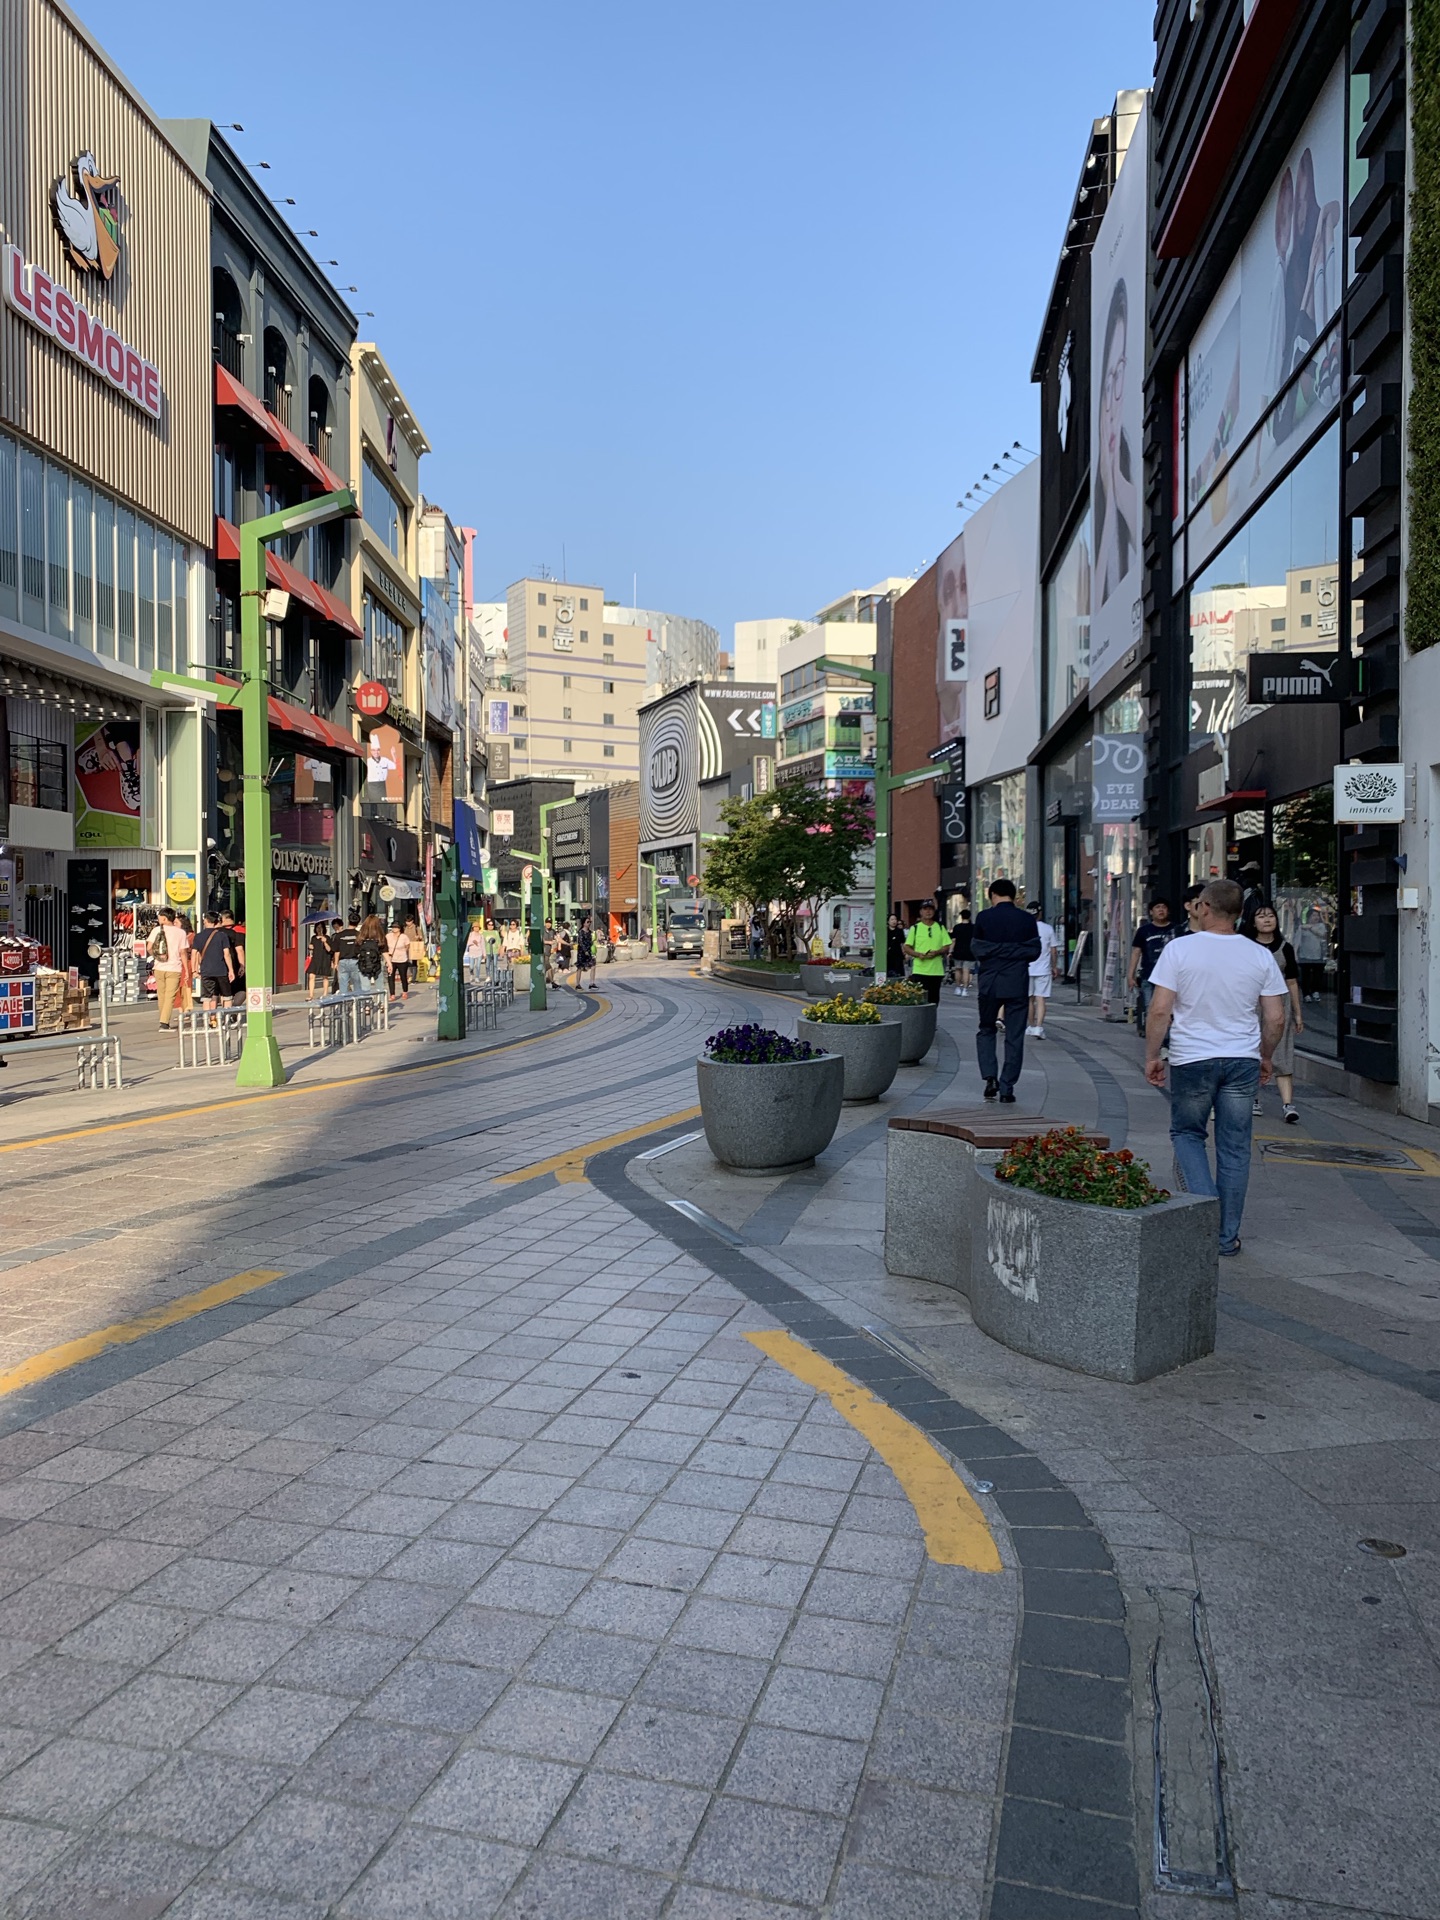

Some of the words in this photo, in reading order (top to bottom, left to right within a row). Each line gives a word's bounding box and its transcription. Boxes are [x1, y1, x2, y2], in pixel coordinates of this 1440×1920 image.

[12, 250, 160, 413] LESMORE
[950, 628, 965, 671] FILA
[704, 689, 776, 700] WWW.FOLDERSTYLE.COM
[1262, 676, 1322, 695] PUMA
[651, 749, 678, 789] FOLDER
[1106, 783, 1135, 795] EYE
[1100, 799, 1140, 810] DEAR
[1348, 805, 1394, 814] innisfree
[271, 848, 300, 872] OLLYS
[300, 852, 333, 876] COFFEE
